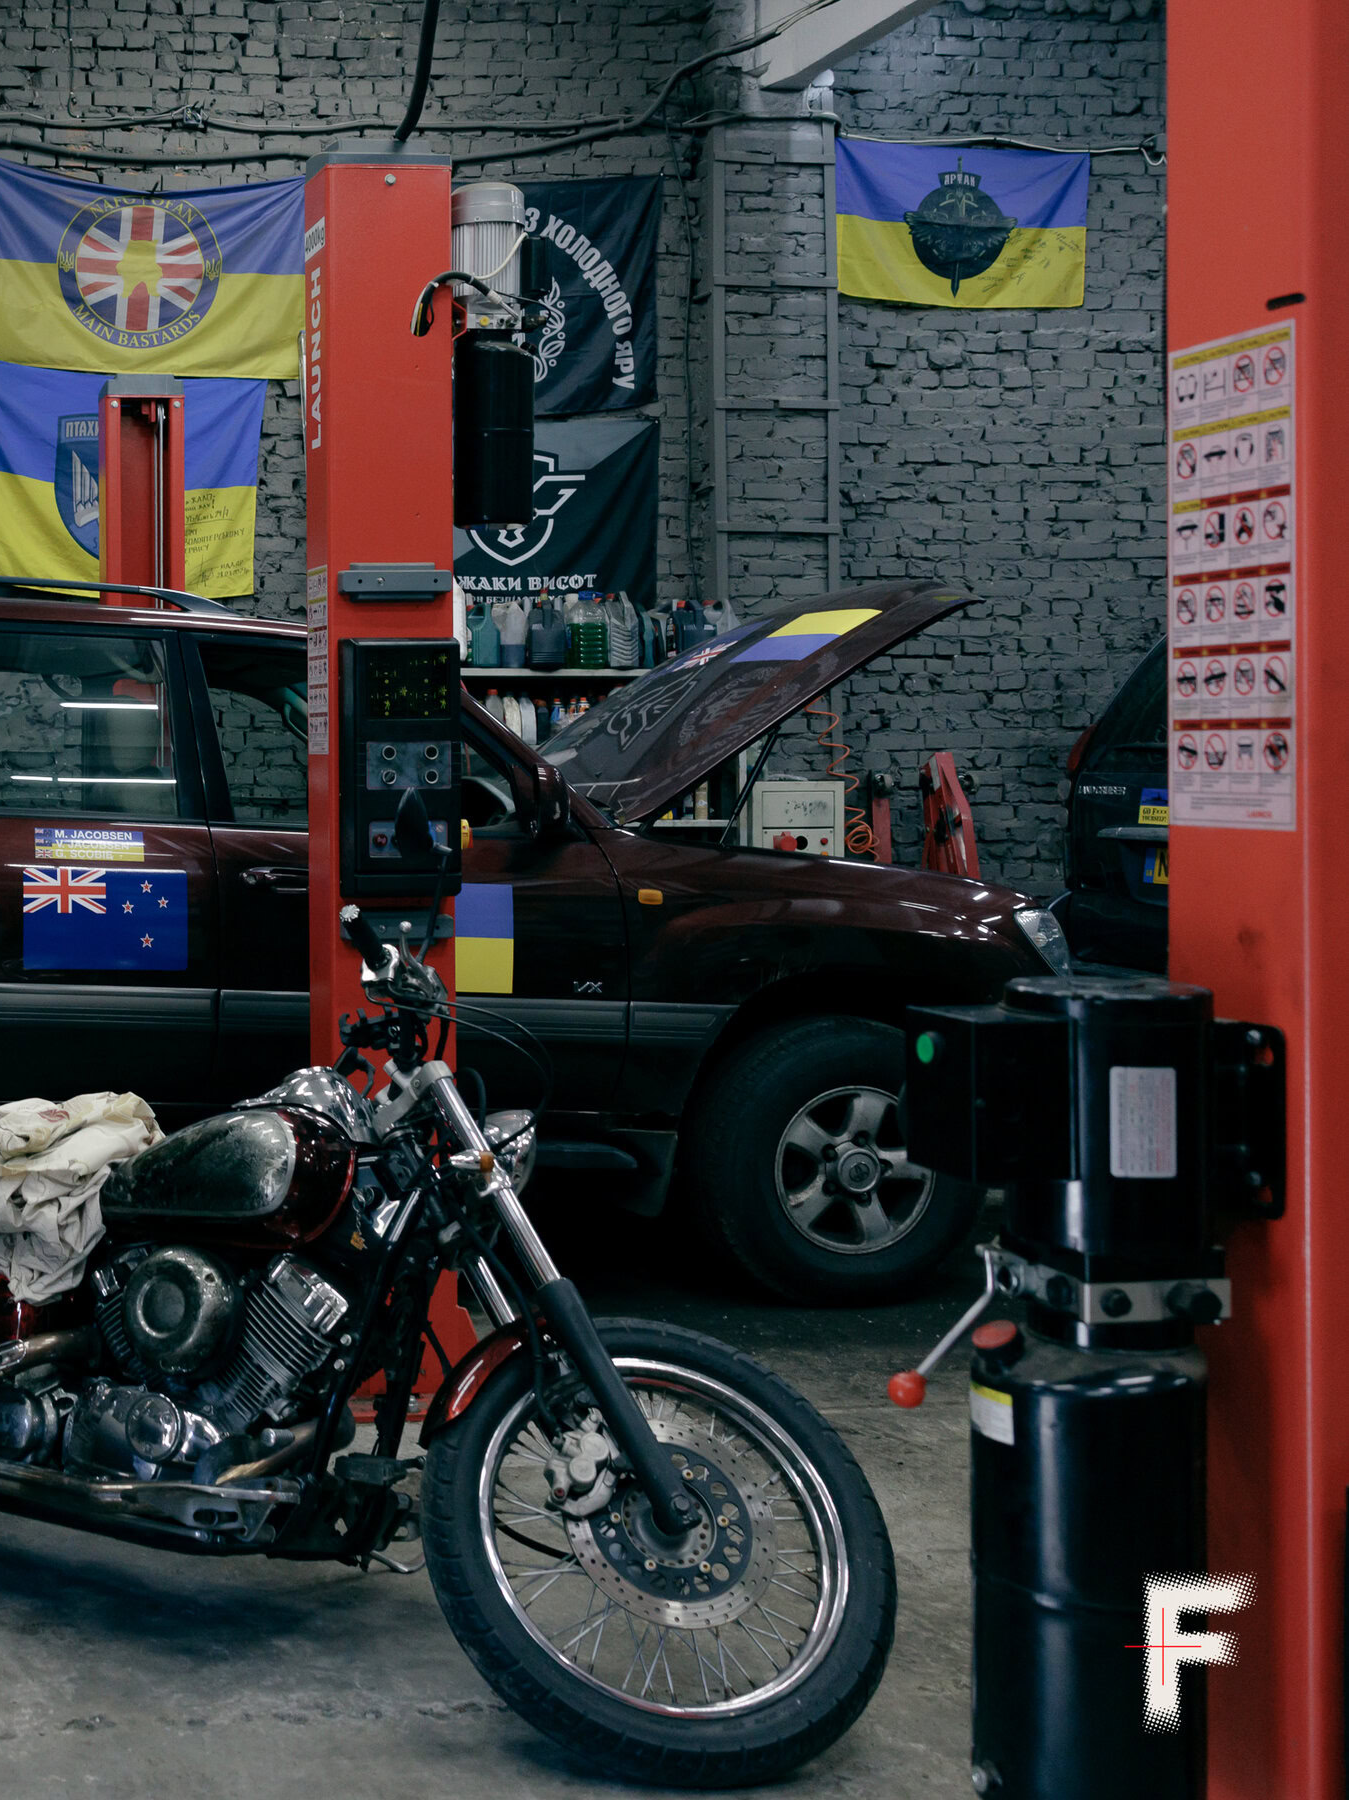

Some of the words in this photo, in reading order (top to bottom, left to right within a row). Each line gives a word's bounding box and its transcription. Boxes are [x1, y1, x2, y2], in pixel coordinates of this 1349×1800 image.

[305, 227, 325, 254] 4000kg
[540, 214, 633, 336] ХОЛОДНОГО
[612, 340, 635, 390] ЯРУ
[73, 303, 115, 340] MAIN
[118, 310, 201, 347] BASTARDS
[311, 266, 322, 450] LAUNCH
[527, 573, 597, 590] ВИСОТ
[55, 830, 68, 839] M.
[70, 831, 132, 841] JACOBSEN
[573, 981, 603, 994] VX
